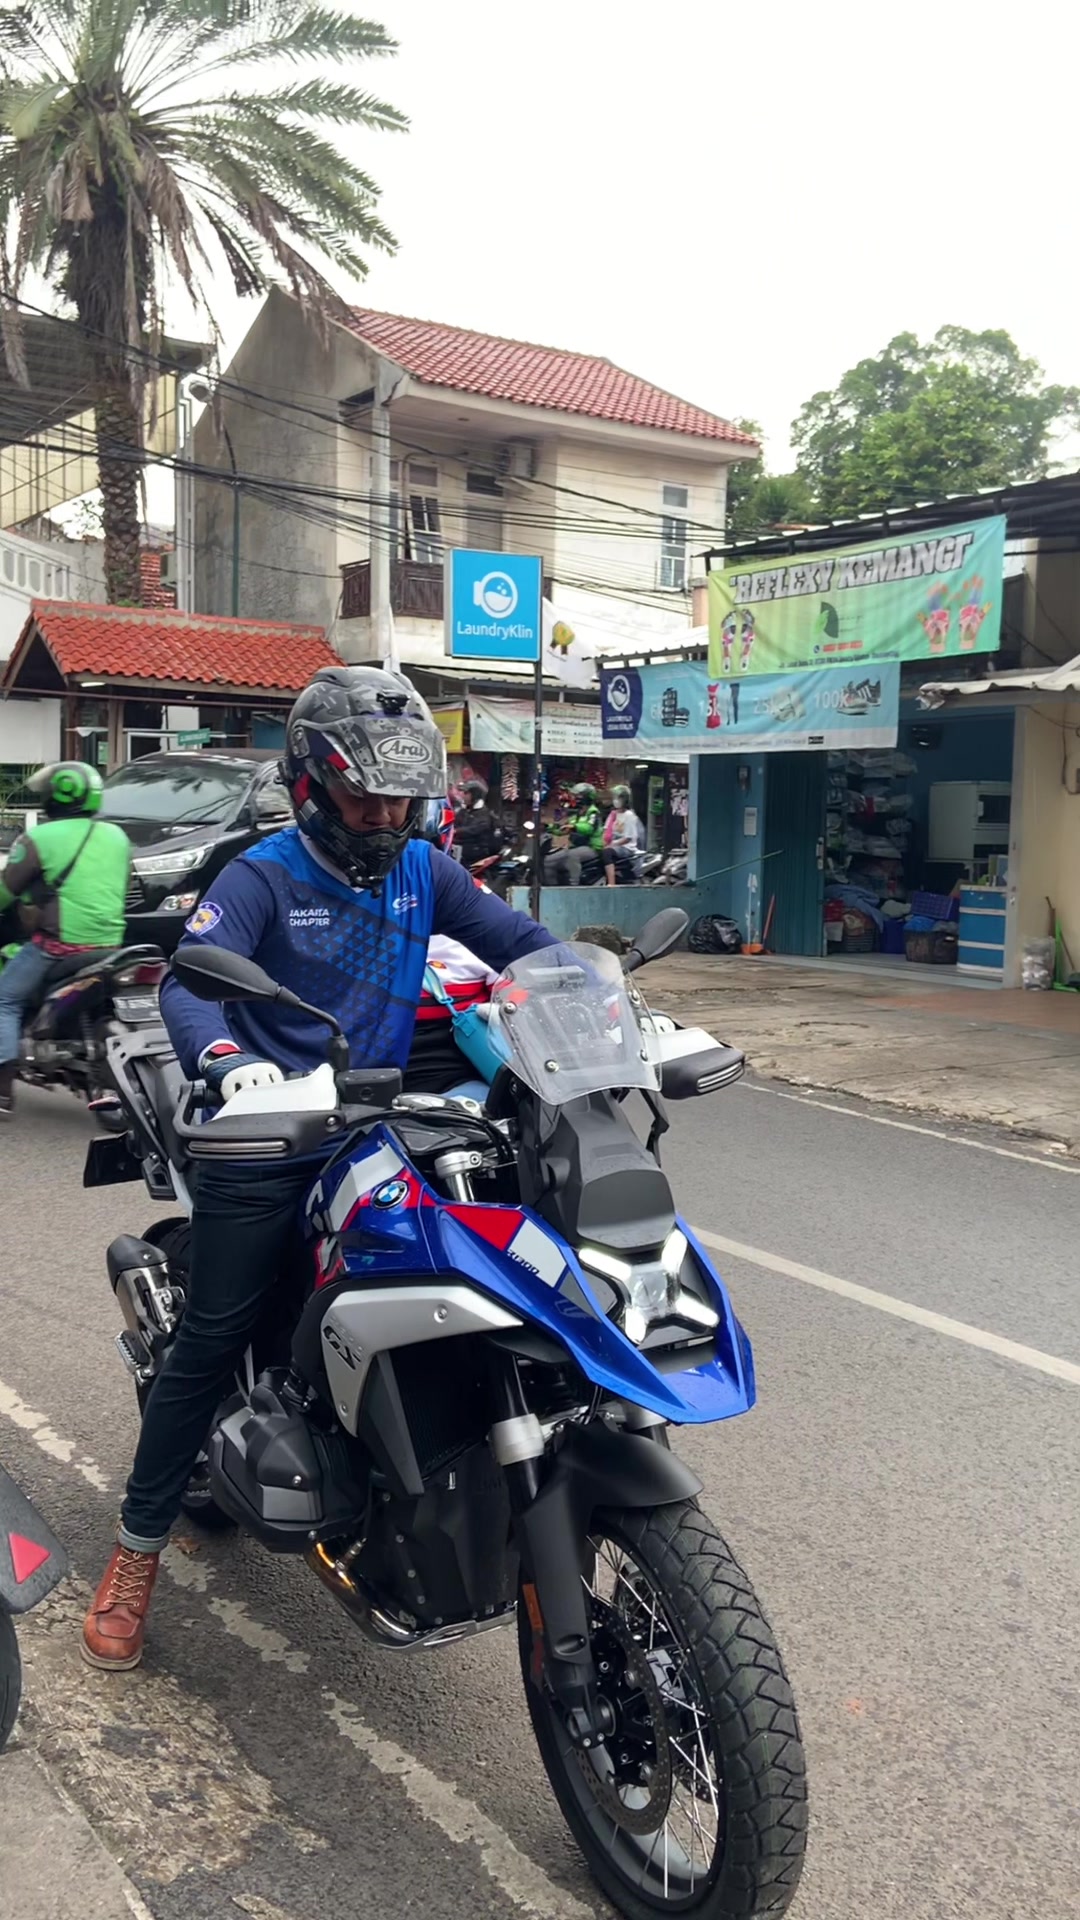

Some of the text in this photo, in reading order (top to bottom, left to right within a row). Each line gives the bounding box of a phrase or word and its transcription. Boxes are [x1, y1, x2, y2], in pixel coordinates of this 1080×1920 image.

[457, 621, 533, 640] LaundryKlin
[382, 740, 424, 757] Arai
[289, 908, 330, 918] JAKARTA
[289, 917, 330, 927] CHAPTER
